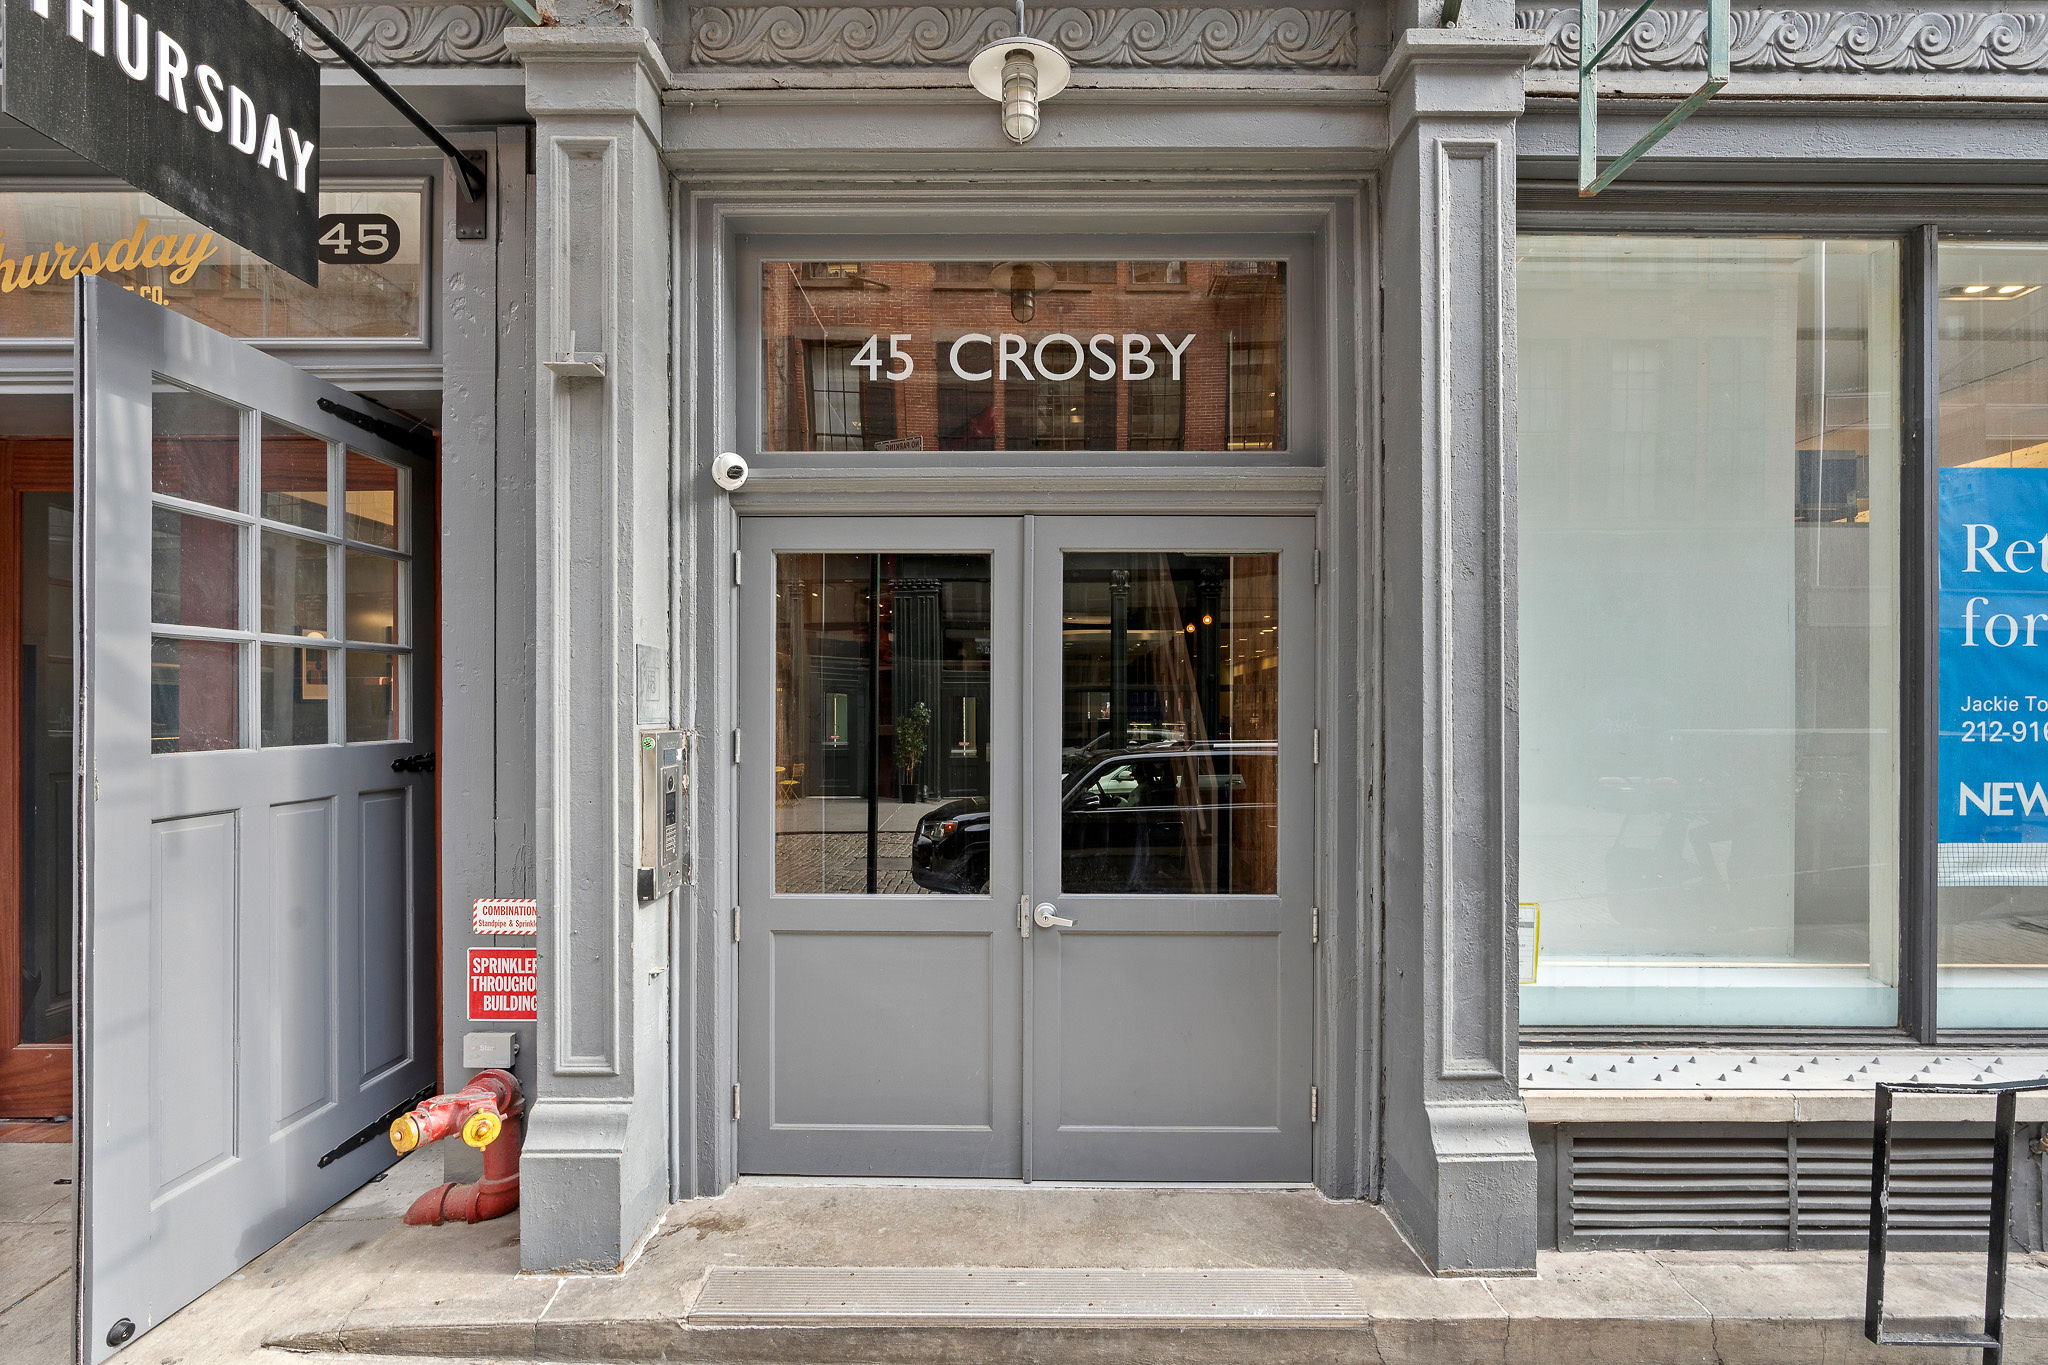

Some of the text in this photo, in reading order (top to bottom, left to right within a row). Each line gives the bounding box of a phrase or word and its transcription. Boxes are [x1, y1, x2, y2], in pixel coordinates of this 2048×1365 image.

[32, 0, 315, 194] HURSDAY
[319, 223, 389, 255] 45
[0, 220, 218, 292] hursday
[850, 333, 1196, 381] 45 CROSBY
[1962, 524, 2048, 573] Ret
[1961, 597, 2048, 647] for
[1960, 696, 2048, 712] Jackie To
[1959, 782, 2048, 816] NEW
[479, 920, 507, 928] Standpipe
[482, 905, 537, 916] COMBINATION
[470, 976, 537, 992] THROUGHO
[483, 995, 537, 1012] BUILDING
